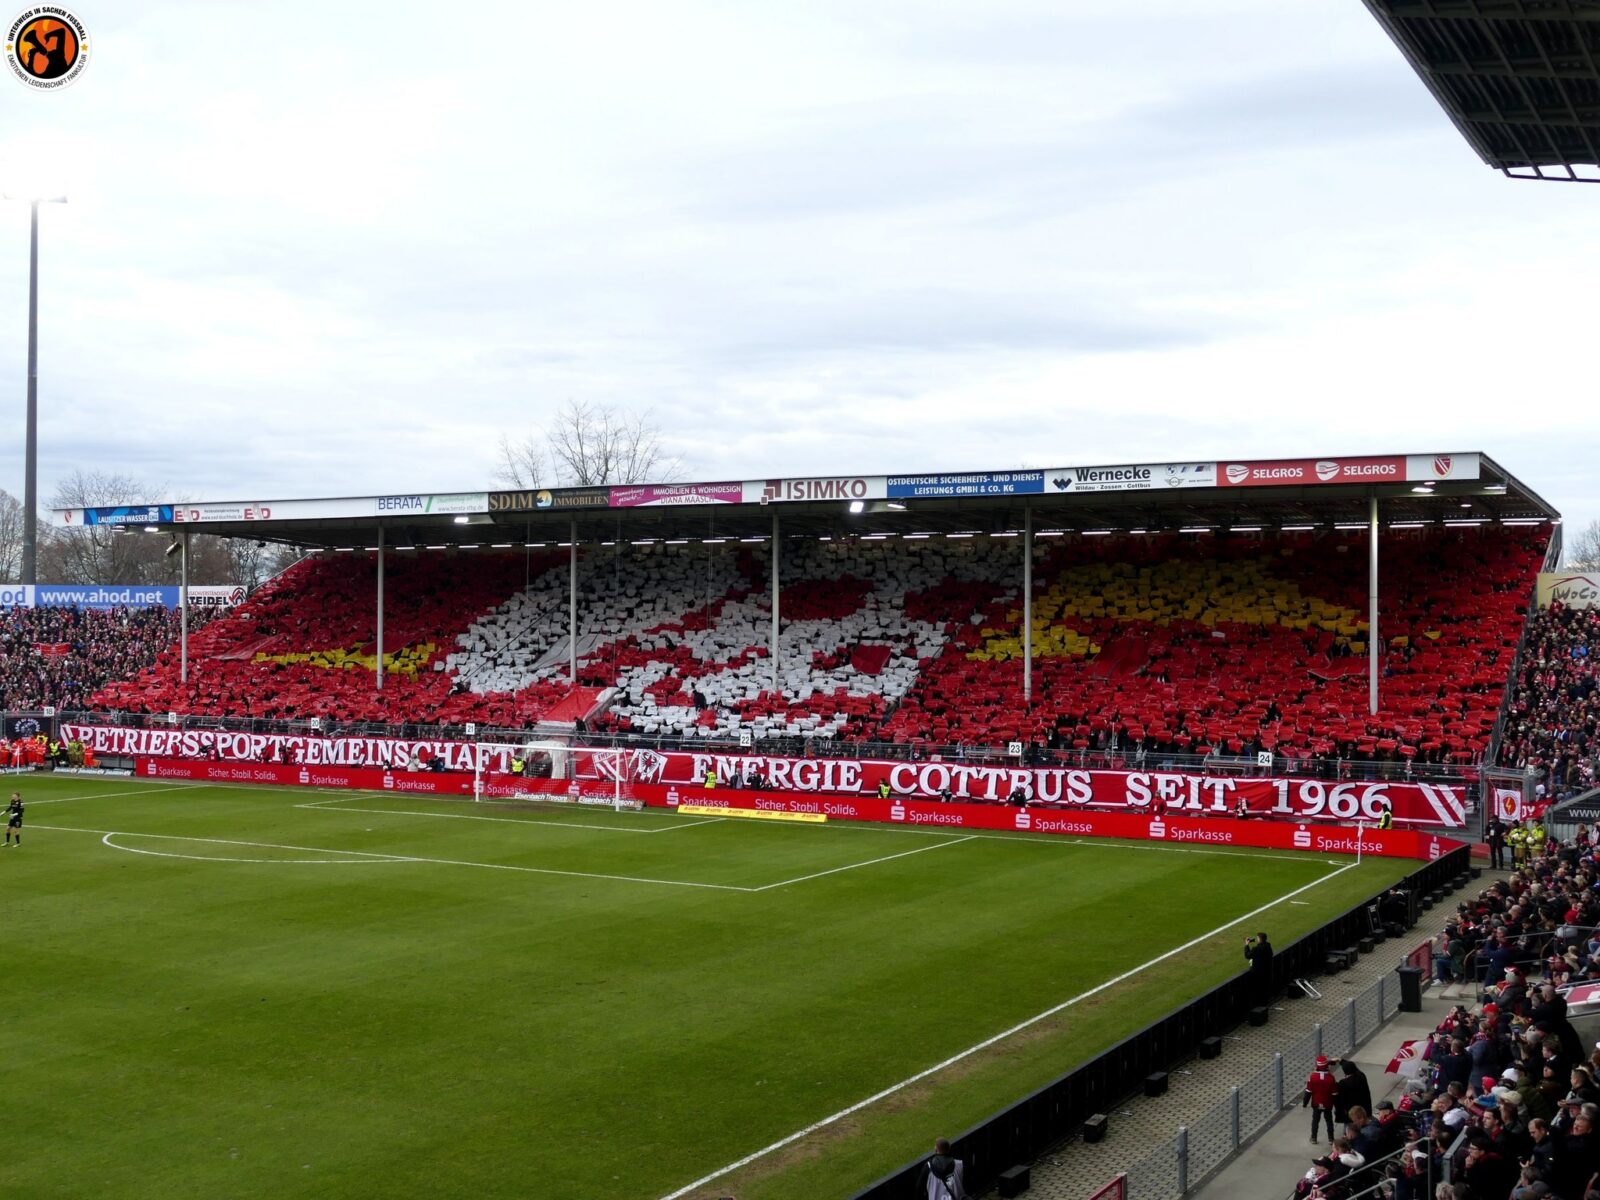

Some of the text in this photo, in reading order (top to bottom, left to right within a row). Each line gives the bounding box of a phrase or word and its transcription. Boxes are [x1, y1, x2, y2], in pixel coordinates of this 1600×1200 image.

[1075, 466, 1151, 482] Wernecke
[1253, 467, 1303, 479] SELGROS
[1344, 464, 1396, 475] SELGROS
[940, 476, 990, 484] SICHERHEITS-
[1013, 473, 1043, 481] DIENST-
[653, 487, 689, 495] IMMOBILIEN
[698, 486, 741, 494] WOHNDESIGN
[786, 480, 867, 500] ISIMKO
[914, 486, 953, 495] LEISTUNGS
[956, 486, 978, 494] GMBH
[980, 485, 986, 493] &
[1003, 484, 1014, 492] KG
[378, 496, 423, 510] BERATA
[489, 493, 533, 510] SDIM
[554, 496, 609, 507] IMMOBILIEN
[660, 496, 682, 504] DIANA
[126, 514, 148, 523] WASSER
[41, 589, 163, 603] www.ahod.net
[187, 597, 229, 605] TEIDEL
[311, 719, 319, 727] 20
[467, 725, 474, 733] 21
[741, 736, 750, 744] 22
[1010, 745, 1020, 754] 23
[1259, 755, 1271, 764] 24
[158, 767, 278, 780] Sparkasse Sicher. Stabil. Solide.
[312, 774, 348, 786] Sparkasse
[397, 779, 435, 791] Sparkasse
[690, 753, 864, 792] ENERGIE
[890, 763, 1093, 804] COTTBUS
[1126, 772, 1237, 812] SEIT
[1271, 779, 1393, 819] 1966
[487, 784, 528, 795] Sparkasse
[514, 792, 546, 801] Eisenbach
[682, 795, 729, 808] Sparkasse
[755, 798, 787, 811] Sicher.
[790, 800, 821, 814] Stabil.
[824, 802, 858, 816] Solide.
[909, 810, 963, 824] Sparkasse
[1035, 818, 1093, 834] Sparkasse
[1171, 826, 1232, 841] Sparkasse
[1317, 836, 1383, 852] Sparkasse
